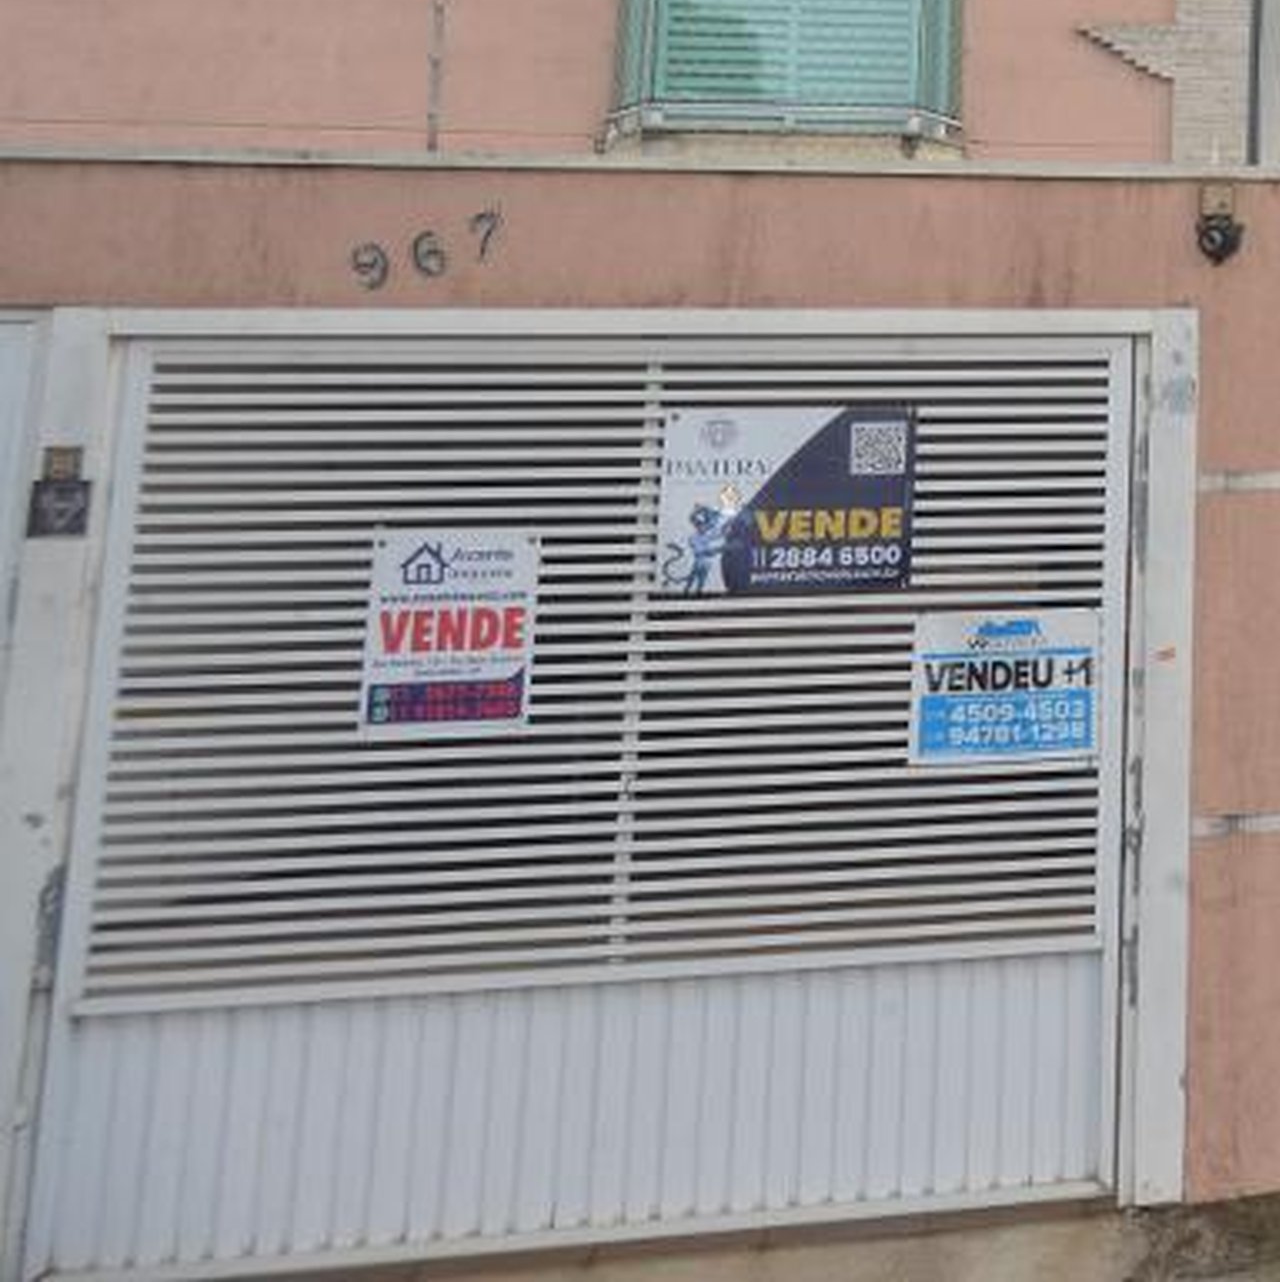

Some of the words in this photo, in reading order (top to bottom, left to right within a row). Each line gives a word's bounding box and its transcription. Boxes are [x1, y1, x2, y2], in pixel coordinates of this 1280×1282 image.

[352, 206, 504, 292] 967
[666, 457, 769, 476] PANTERA
[755, 506, 903, 541] VENDE
[771, 547, 833, 567] 2884
[840, 544, 901, 565] 6500
[379, 606, 527, 655] VENDE
[924, 656, 1054, 692] VENDEU
